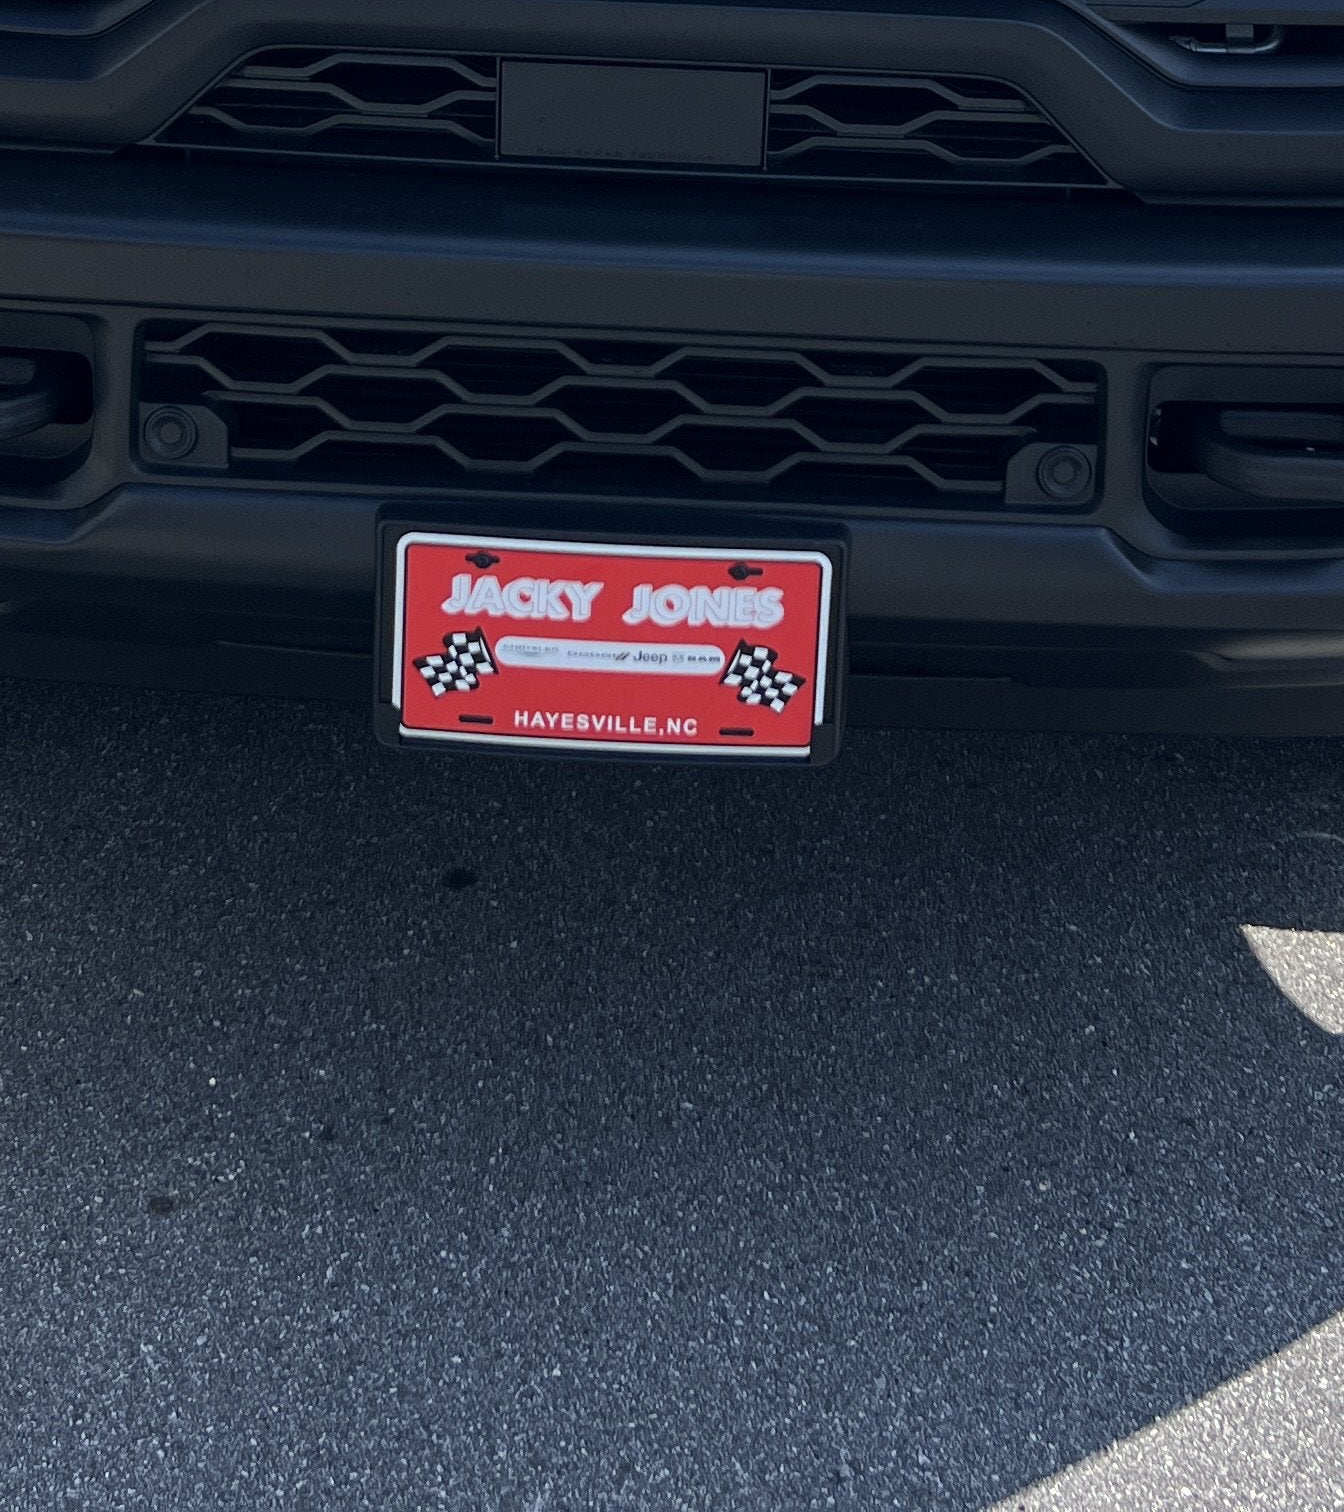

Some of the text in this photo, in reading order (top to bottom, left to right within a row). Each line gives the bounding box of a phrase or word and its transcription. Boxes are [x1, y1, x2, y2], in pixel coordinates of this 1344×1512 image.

[441, 574, 785, 629] JACKY JONES
[633, 650, 668, 664] Jeep
